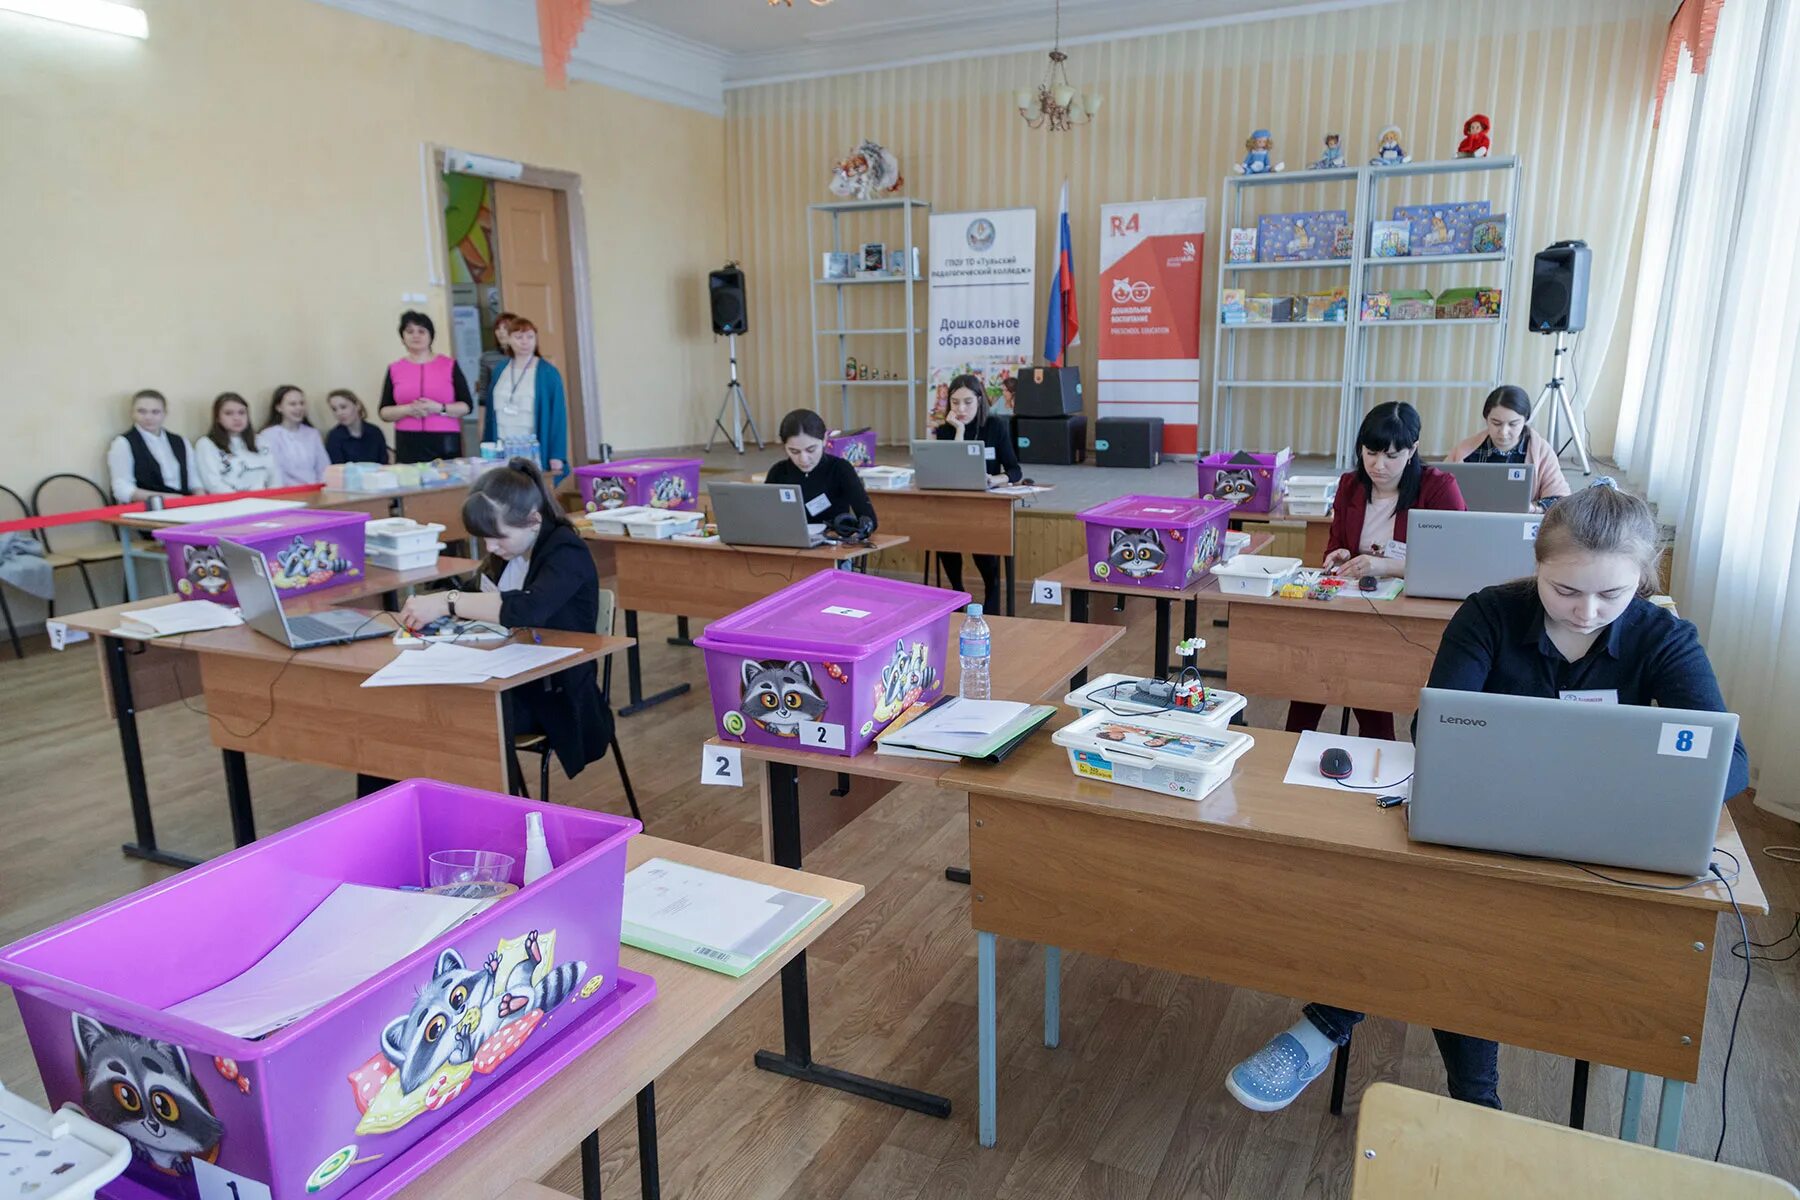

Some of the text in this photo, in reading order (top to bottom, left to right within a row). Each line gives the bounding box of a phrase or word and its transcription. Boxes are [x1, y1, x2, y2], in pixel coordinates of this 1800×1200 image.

[1110, 213, 1140, 237] R4
[940, 318, 1020, 332] Дошкольное
[938, 334, 1021, 348] образование
[1514, 470, 1520, 479] 6
[1418, 522, 1442, 530] Lenovo
[1043, 587, 1054, 600] 3
[1439, 714, 1487, 728] Lenovo
[817, 726, 827, 744] 2
[1675, 730, 1694, 752] 8
[715, 756, 731, 777] 2
